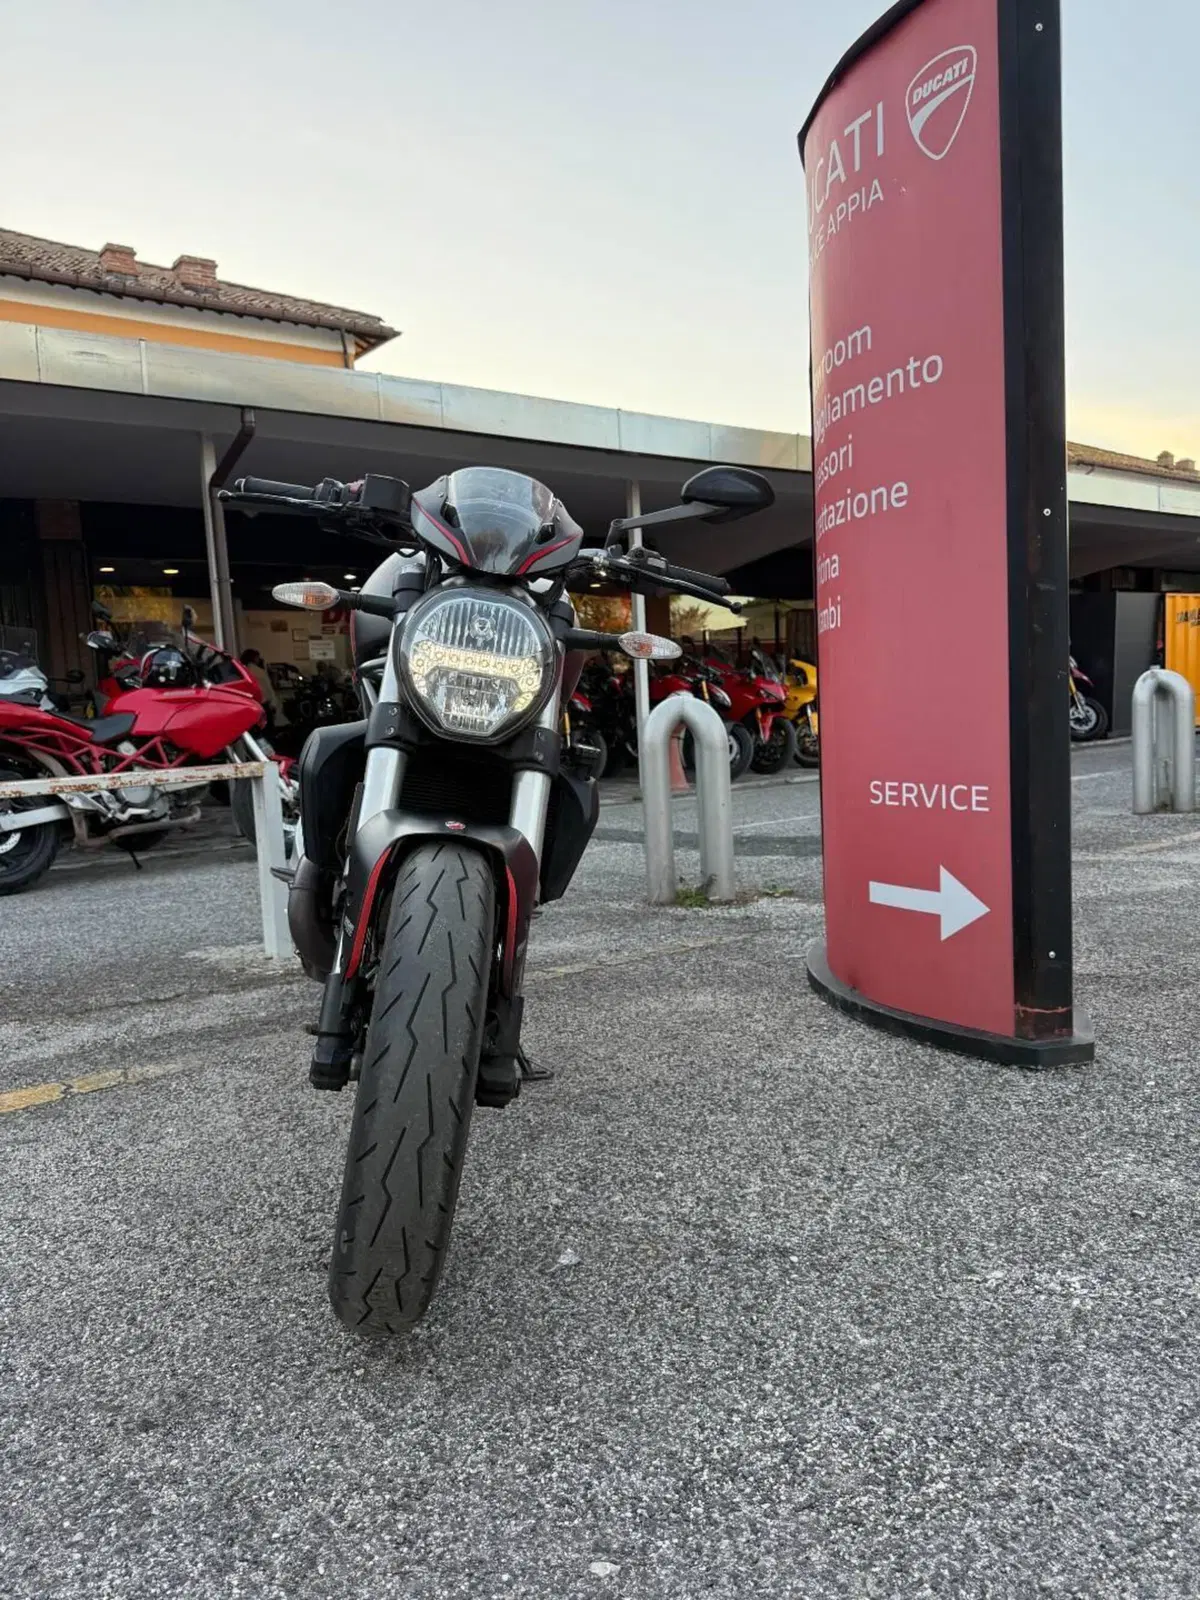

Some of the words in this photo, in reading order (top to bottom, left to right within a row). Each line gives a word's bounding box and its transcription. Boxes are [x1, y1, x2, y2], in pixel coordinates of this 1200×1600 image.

[912, 57, 969, 105] DUCATI
[807, 101, 884, 235] UCATI
[826, 178, 884, 242] APPIA
[869, 780, 990, 812] SERVICE
